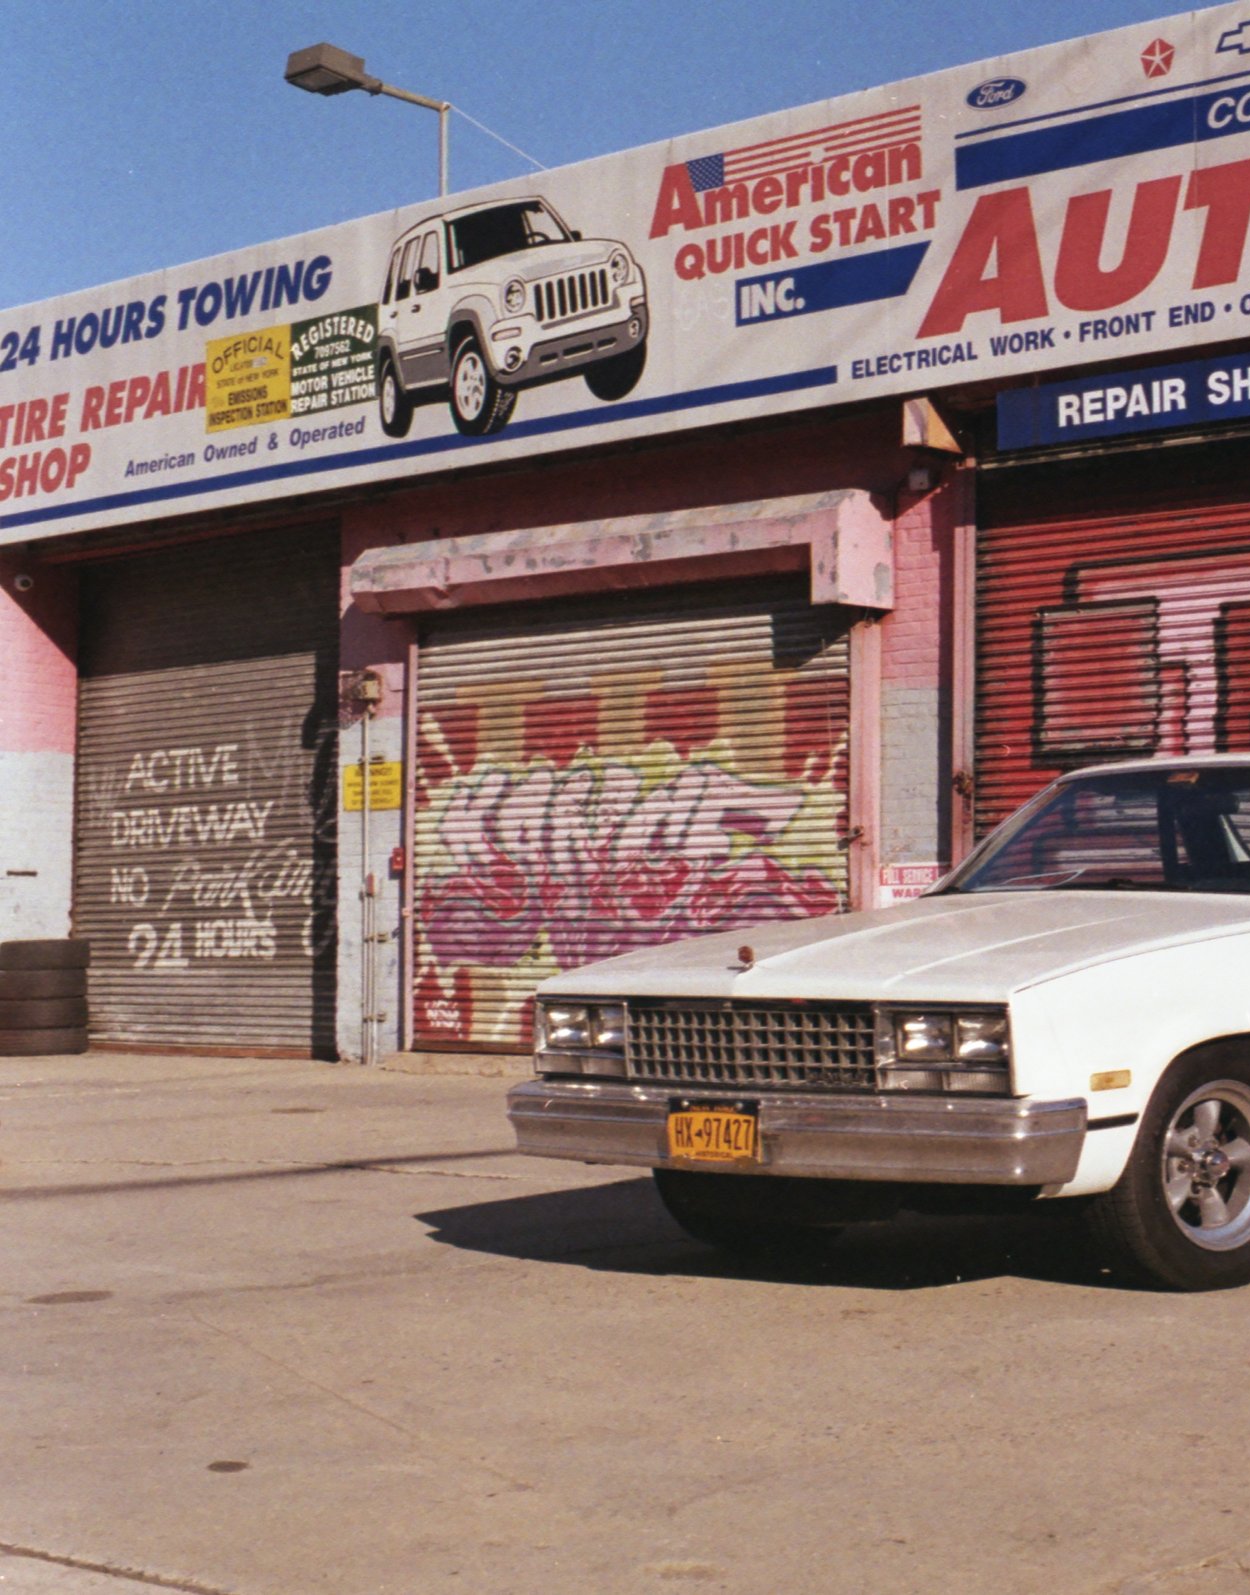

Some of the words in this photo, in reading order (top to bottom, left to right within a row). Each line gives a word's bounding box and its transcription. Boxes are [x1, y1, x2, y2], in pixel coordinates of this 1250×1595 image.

[976, 82, 1015, 106] Ford
[649, 142, 922, 240] American
[674, 220, 799, 281] QUICK
[809, 189, 941, 253] START
[0, 323, 41, 372] 24
[50, 295, 167, 361] HOURS
[177, 255, 332, 331] TOWING
[740, 277, 806, 320] INC.
[211, 336, 285, 374] OFFICIAL
[291, 316, 375, 361] REGISTERED
[851, 341, 978, 381] ELECTRICAL
[990, 327, 1056, 358] WORK
[1078, 310, 1156, 343] FRONT
[1169, 300, 1216, 329] END
[291, 376, 328, 396] MOTOR
[331, 365, 375, 388] VEHICLE
[292, 363, 318, 377] STATE
[319, 360, 330, 371] OF
[331, 357, 349, 368] NEW
[351, 352, 374, 364] YORK
[208, 407, 253, 426] INSPECTION
[256, 400, 288, 418] STATION
[227, 385, 268, 406] EMISSIONS
[291, 393, 328, 413] REPAIR
[331, 382, 376, 406] STATION
[1057, 377, 1187, 428] REPAIR
[0, 393, 69, 449] TIRE
[124, 449, 195, 478] American
[203, 438, 258, 463] Owned
[267, 432, 279, 450] &
[289, 415, 366, 450] Operated
[0, 443, 91, 500] SHOP
[124, 744, 239, 793] ACTIVE
[111, 801, 274, 849] DRIVEWAY
[110, 866, 150, 908] NO
[195, 916, 277, 960] HOURS
